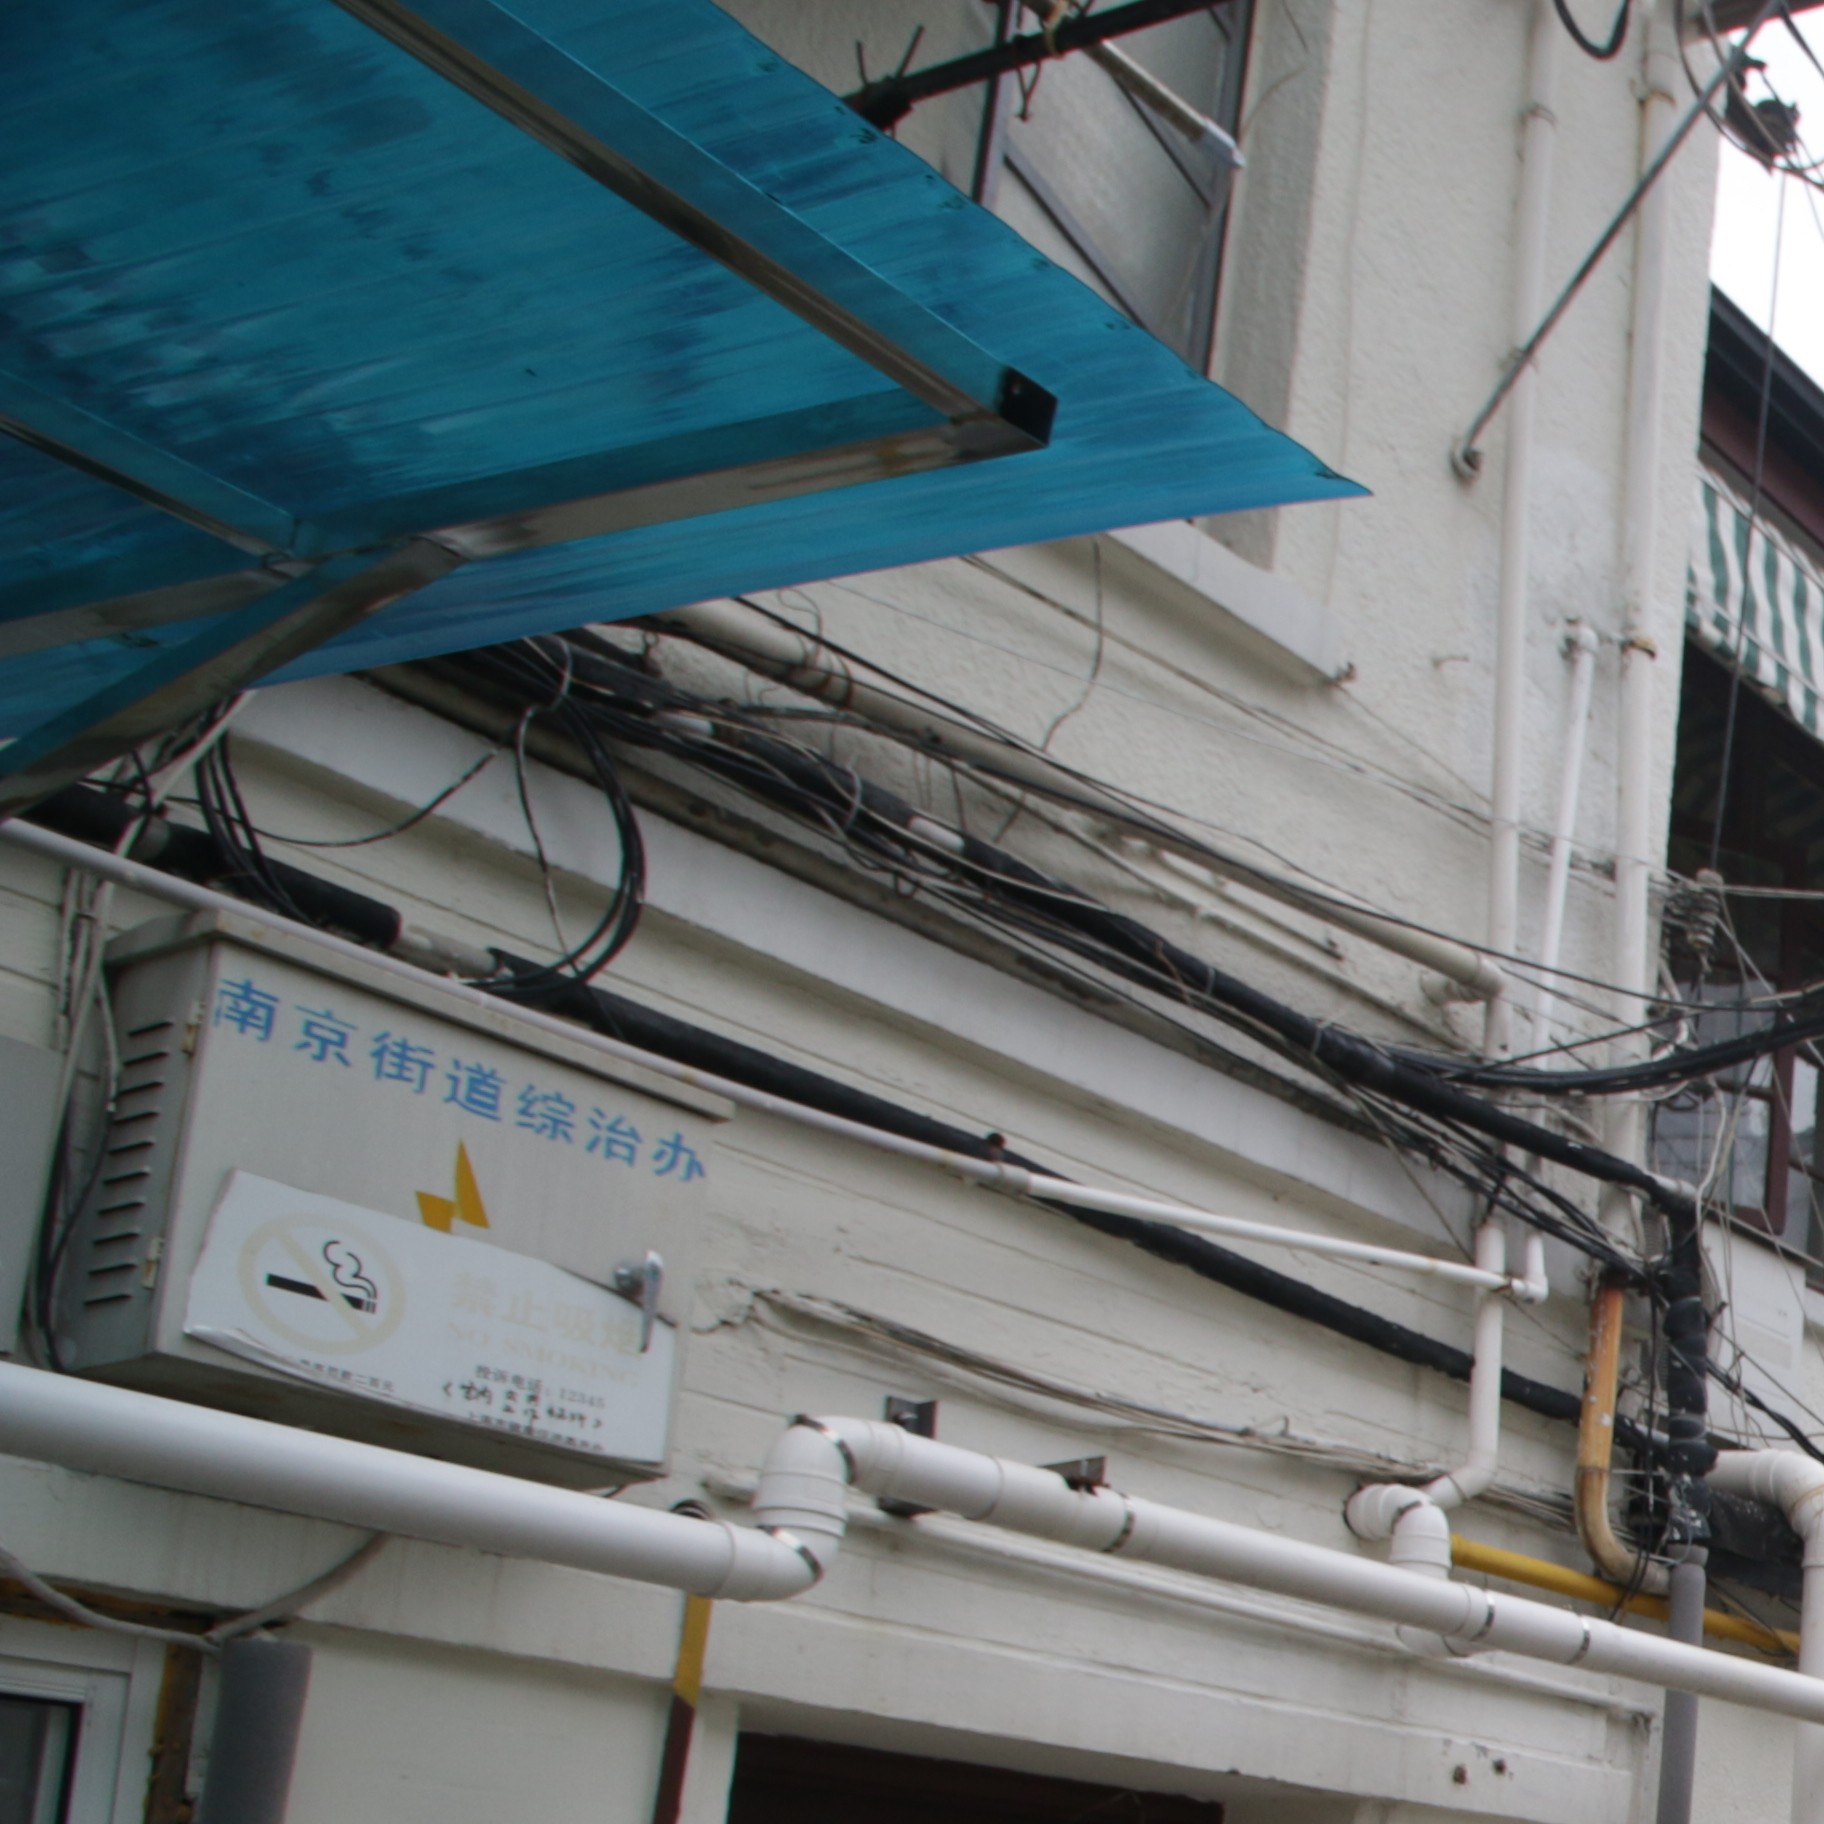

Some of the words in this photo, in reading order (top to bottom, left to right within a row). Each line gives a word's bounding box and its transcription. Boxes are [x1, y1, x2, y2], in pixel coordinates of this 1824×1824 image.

[214, 977, 706, 1183] 南京街道综治办
